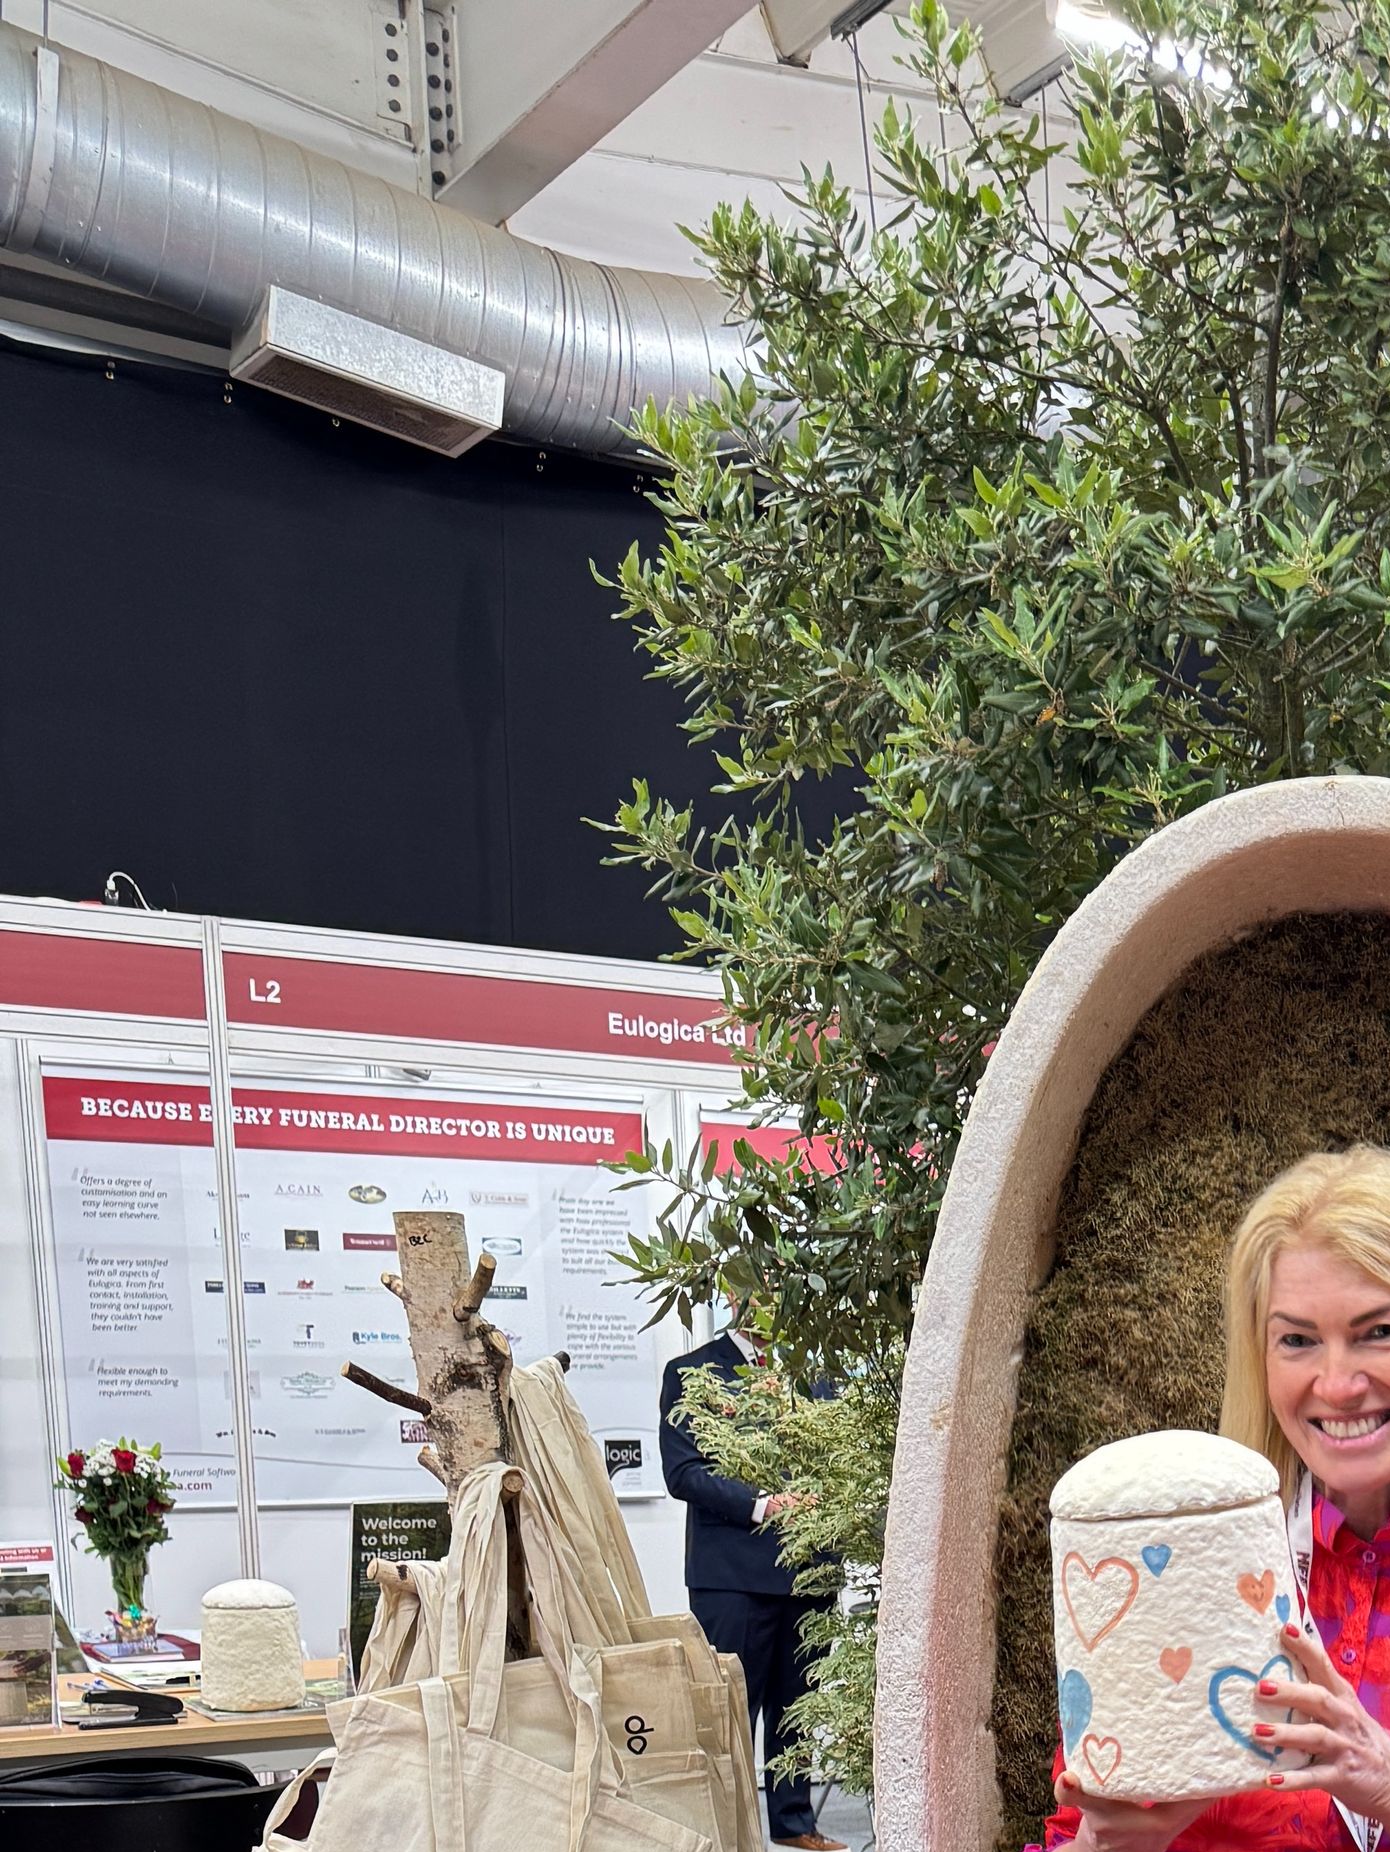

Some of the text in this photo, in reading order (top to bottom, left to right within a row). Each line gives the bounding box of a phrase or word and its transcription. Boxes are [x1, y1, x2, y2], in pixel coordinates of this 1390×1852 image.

[249, 979, 281, 1004] L2
[608, 1012, 705, 1045] Eulogica
[81, 1097, 616, 1146] BECAUSE EERY FUNERAL DIRECTOR IS UNIQUE
[361, 1516, 437, 1531] Welcome
[361, 1532, 409, 1546] to the
[361, 1547, 427, 1562] mission!
